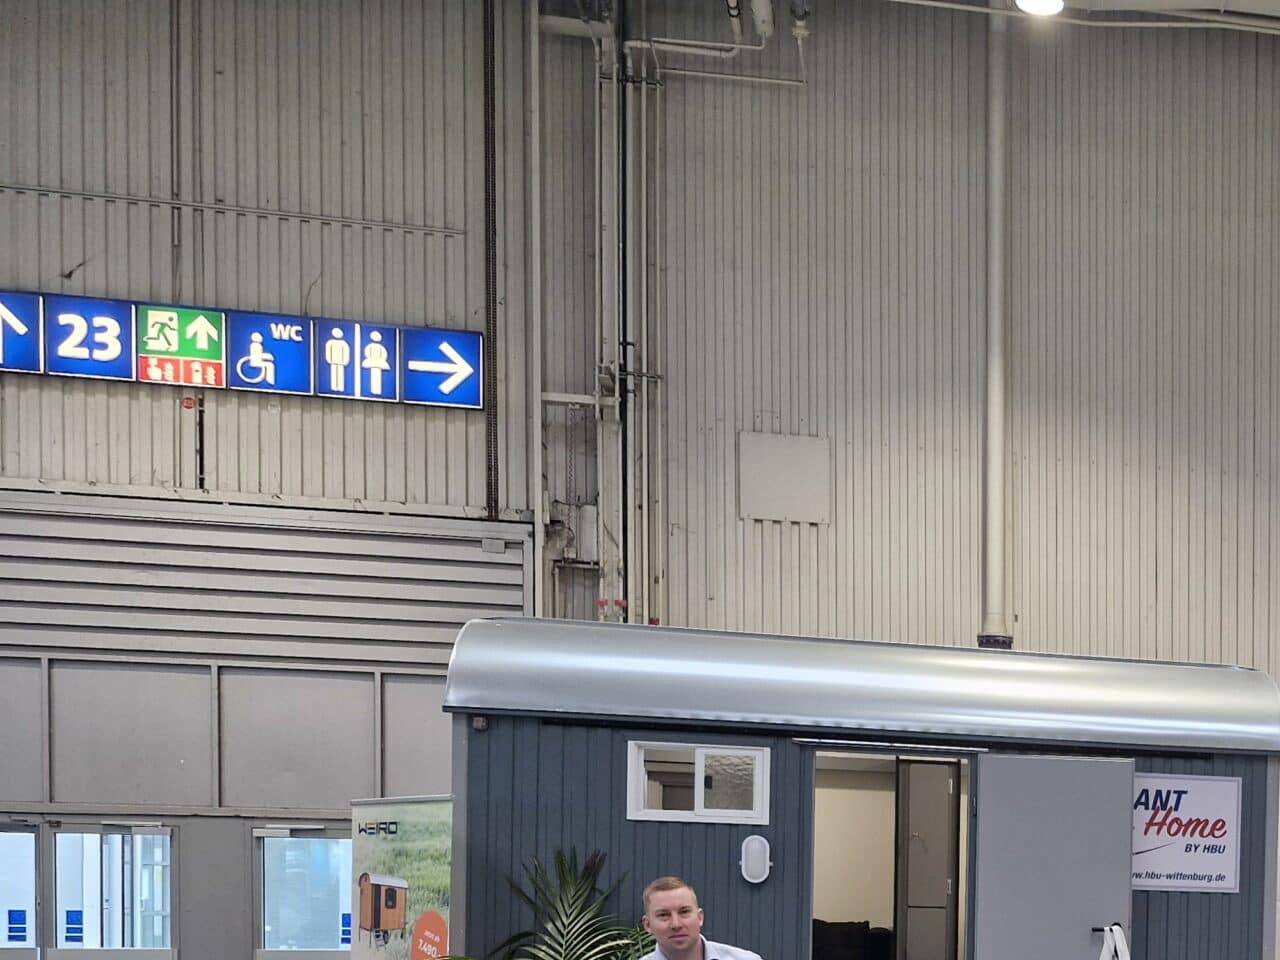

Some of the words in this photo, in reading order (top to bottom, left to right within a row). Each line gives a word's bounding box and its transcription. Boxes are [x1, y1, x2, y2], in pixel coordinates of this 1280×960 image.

[56, 313, 122, 362] 23
[270, 322, 303, 342] WC
[358, 821, 398, 835] WEIRO
[1143, 804, 1227, 839] Home
[1184, 843, 1200, 854] BY
[1202, 844, 1226, 855] HBU
